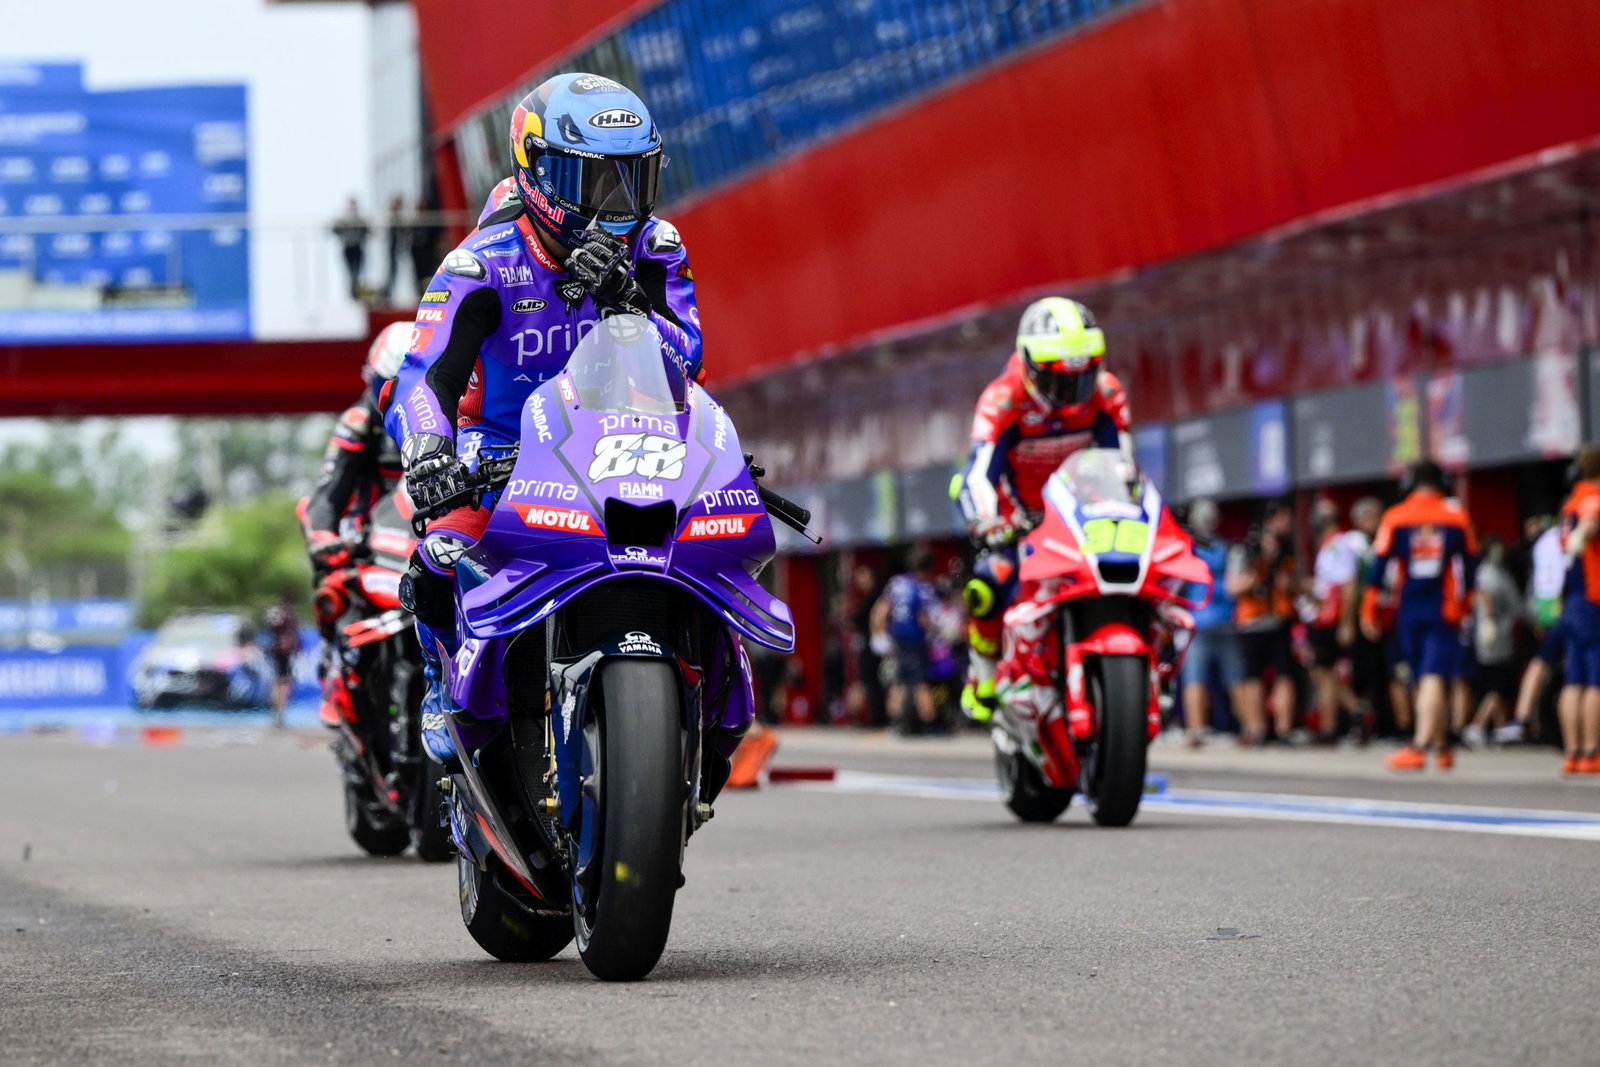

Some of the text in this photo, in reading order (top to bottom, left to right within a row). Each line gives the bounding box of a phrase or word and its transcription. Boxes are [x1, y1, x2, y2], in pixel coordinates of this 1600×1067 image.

[598, 113, 636, 126] HJC
[570, 149, 605, 160] PRAMAC
[519, 168, 540, 204] Red
[537, 191, 565, 225] Bull
[613, 213, 636, 222] Cofidis
[473, 226, 515, 249] IXON
[527, 234, 558, 271] PRAMAC
[498, 265, 534, 284] FIAMM
[418, 309, 444, 321] TUL
[514, 301, 542, 312] HJC
[408, 386, 437, 430] prima
[528, 393, 553, 443] PRAMAC
[599, 415, 677, 435] prima
[588, 432, 687, 484] 88
[508, 479, 579, 501] prima
[620, 482, 663, 497] FIAMM
[699, 487, 760, 514] prima
[525, 508, 591, 531] MOTUL
[690, 515, 746, 537] MOTUL
[610, 554, 667, 563] PRAMAC
[619, 643, 663, 655] YAMAHA
